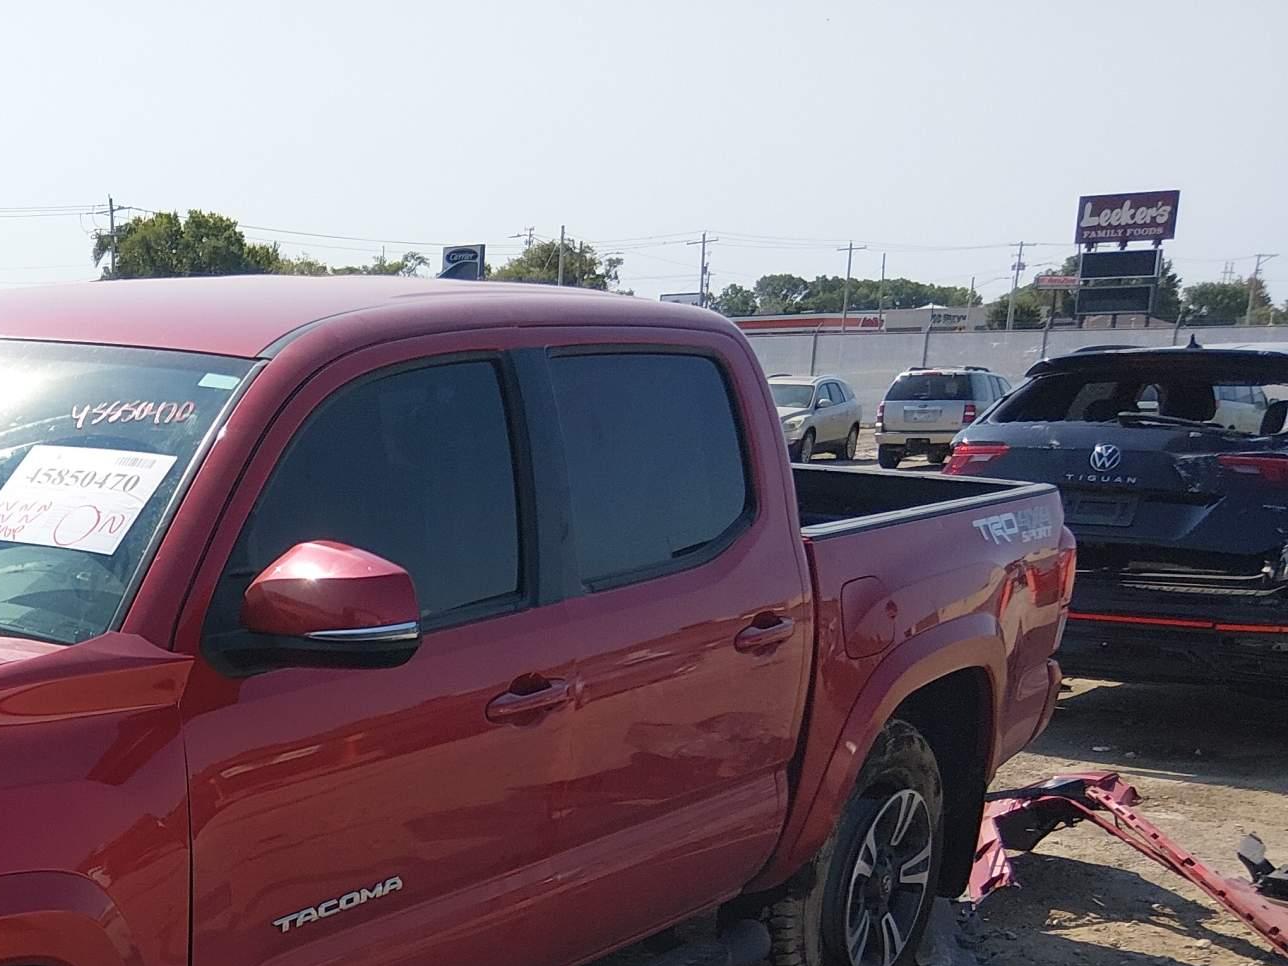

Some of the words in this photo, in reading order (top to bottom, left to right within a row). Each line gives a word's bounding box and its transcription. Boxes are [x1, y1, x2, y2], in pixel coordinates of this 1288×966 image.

[1080, 200, 1171, 227] Leeker's
[1083, 229, 1124, 238] FAMILY
[1126, 227, 1163, 236] FOODS
[26, 467, 140, 492] 45850470
[1065, 474, 1137, 484] TIGUAN
[972, 512, 1018, 544] TRD
[272, 876, 403, 933] TACOMA
